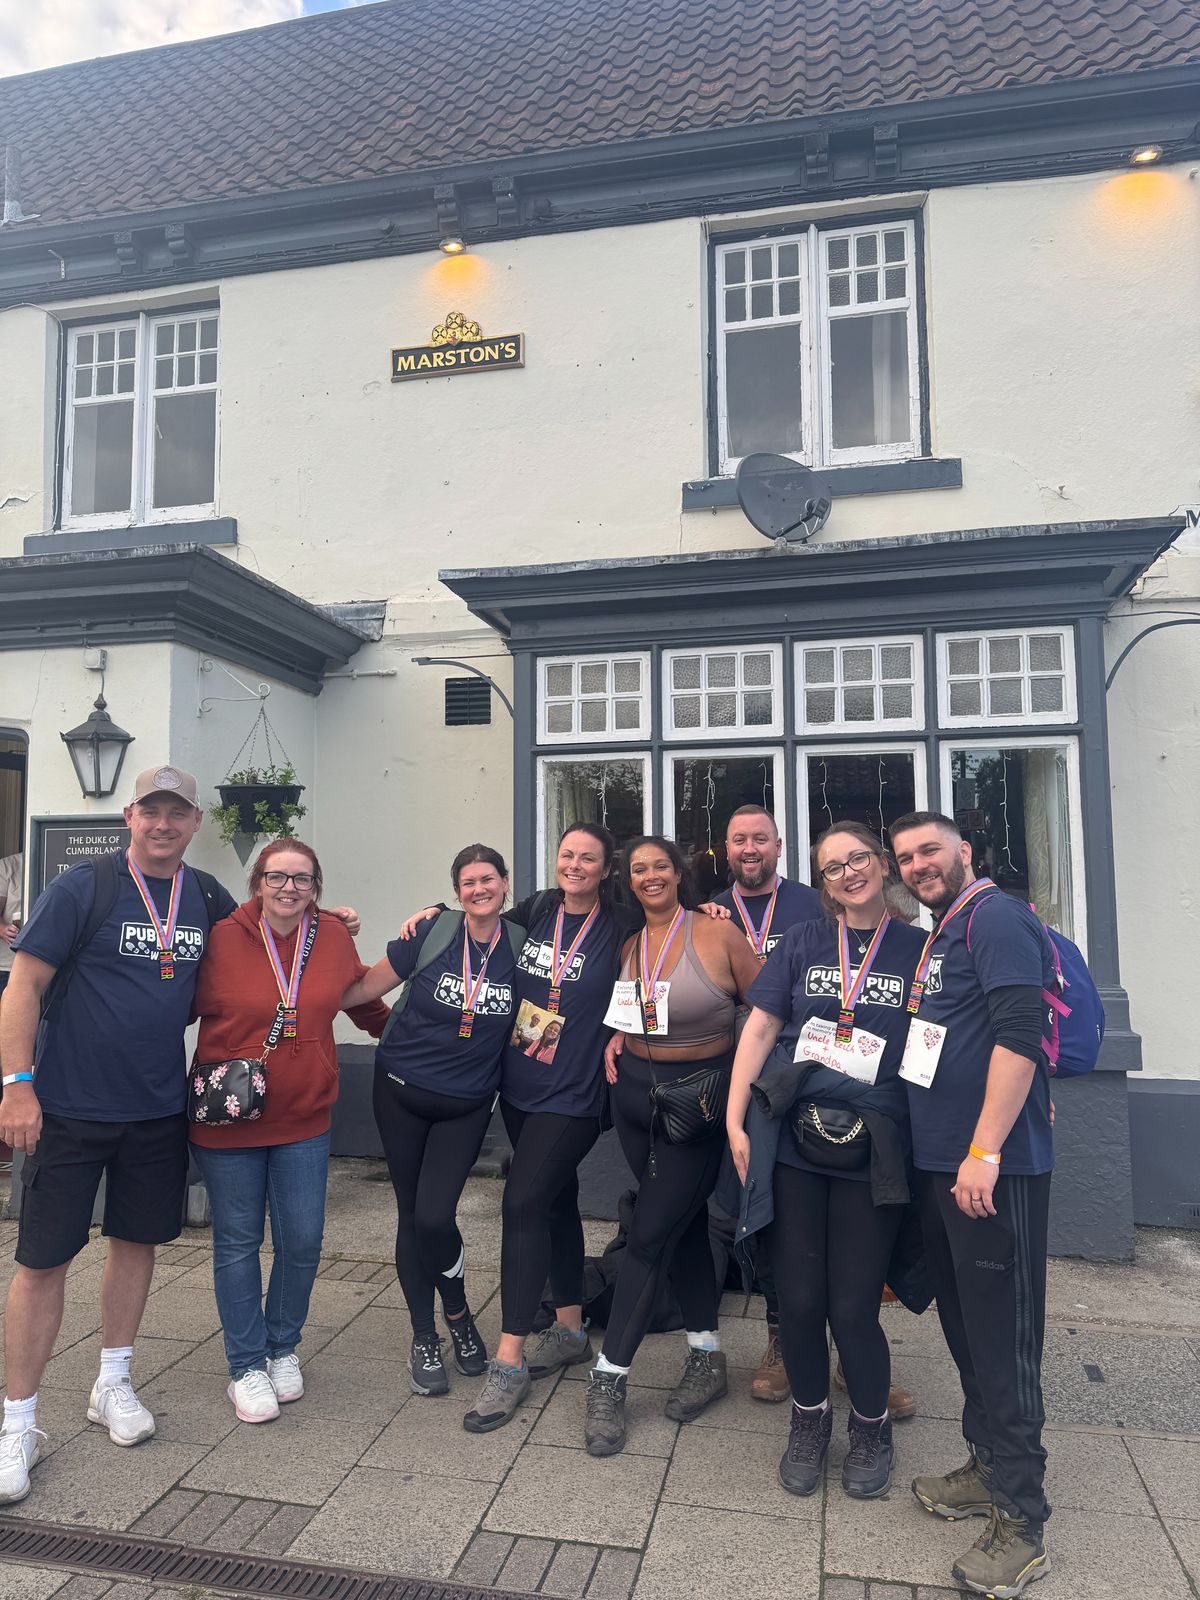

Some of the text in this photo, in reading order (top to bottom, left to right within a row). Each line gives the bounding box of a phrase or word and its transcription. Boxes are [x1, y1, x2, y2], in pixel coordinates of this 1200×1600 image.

[396, 342, 516, 372] MARSTON'S
[68, 835, 120, 845] THE DUKE OF
[126, 926, 202, 945] PUB PUB
[303, 927, 316, 957] GUESS
[150, 950, 178, 962] WK
[866, 976, 901, 992] PUB
[487, 987, 510, 1001] PUB
[268, 1010, 284, 1044] GUESS
[807, 1031, 830, 1044] Uncle
[803, 1045, 842, 1071] Grandpa
[975, 1260, 1006, 1270] adidas
